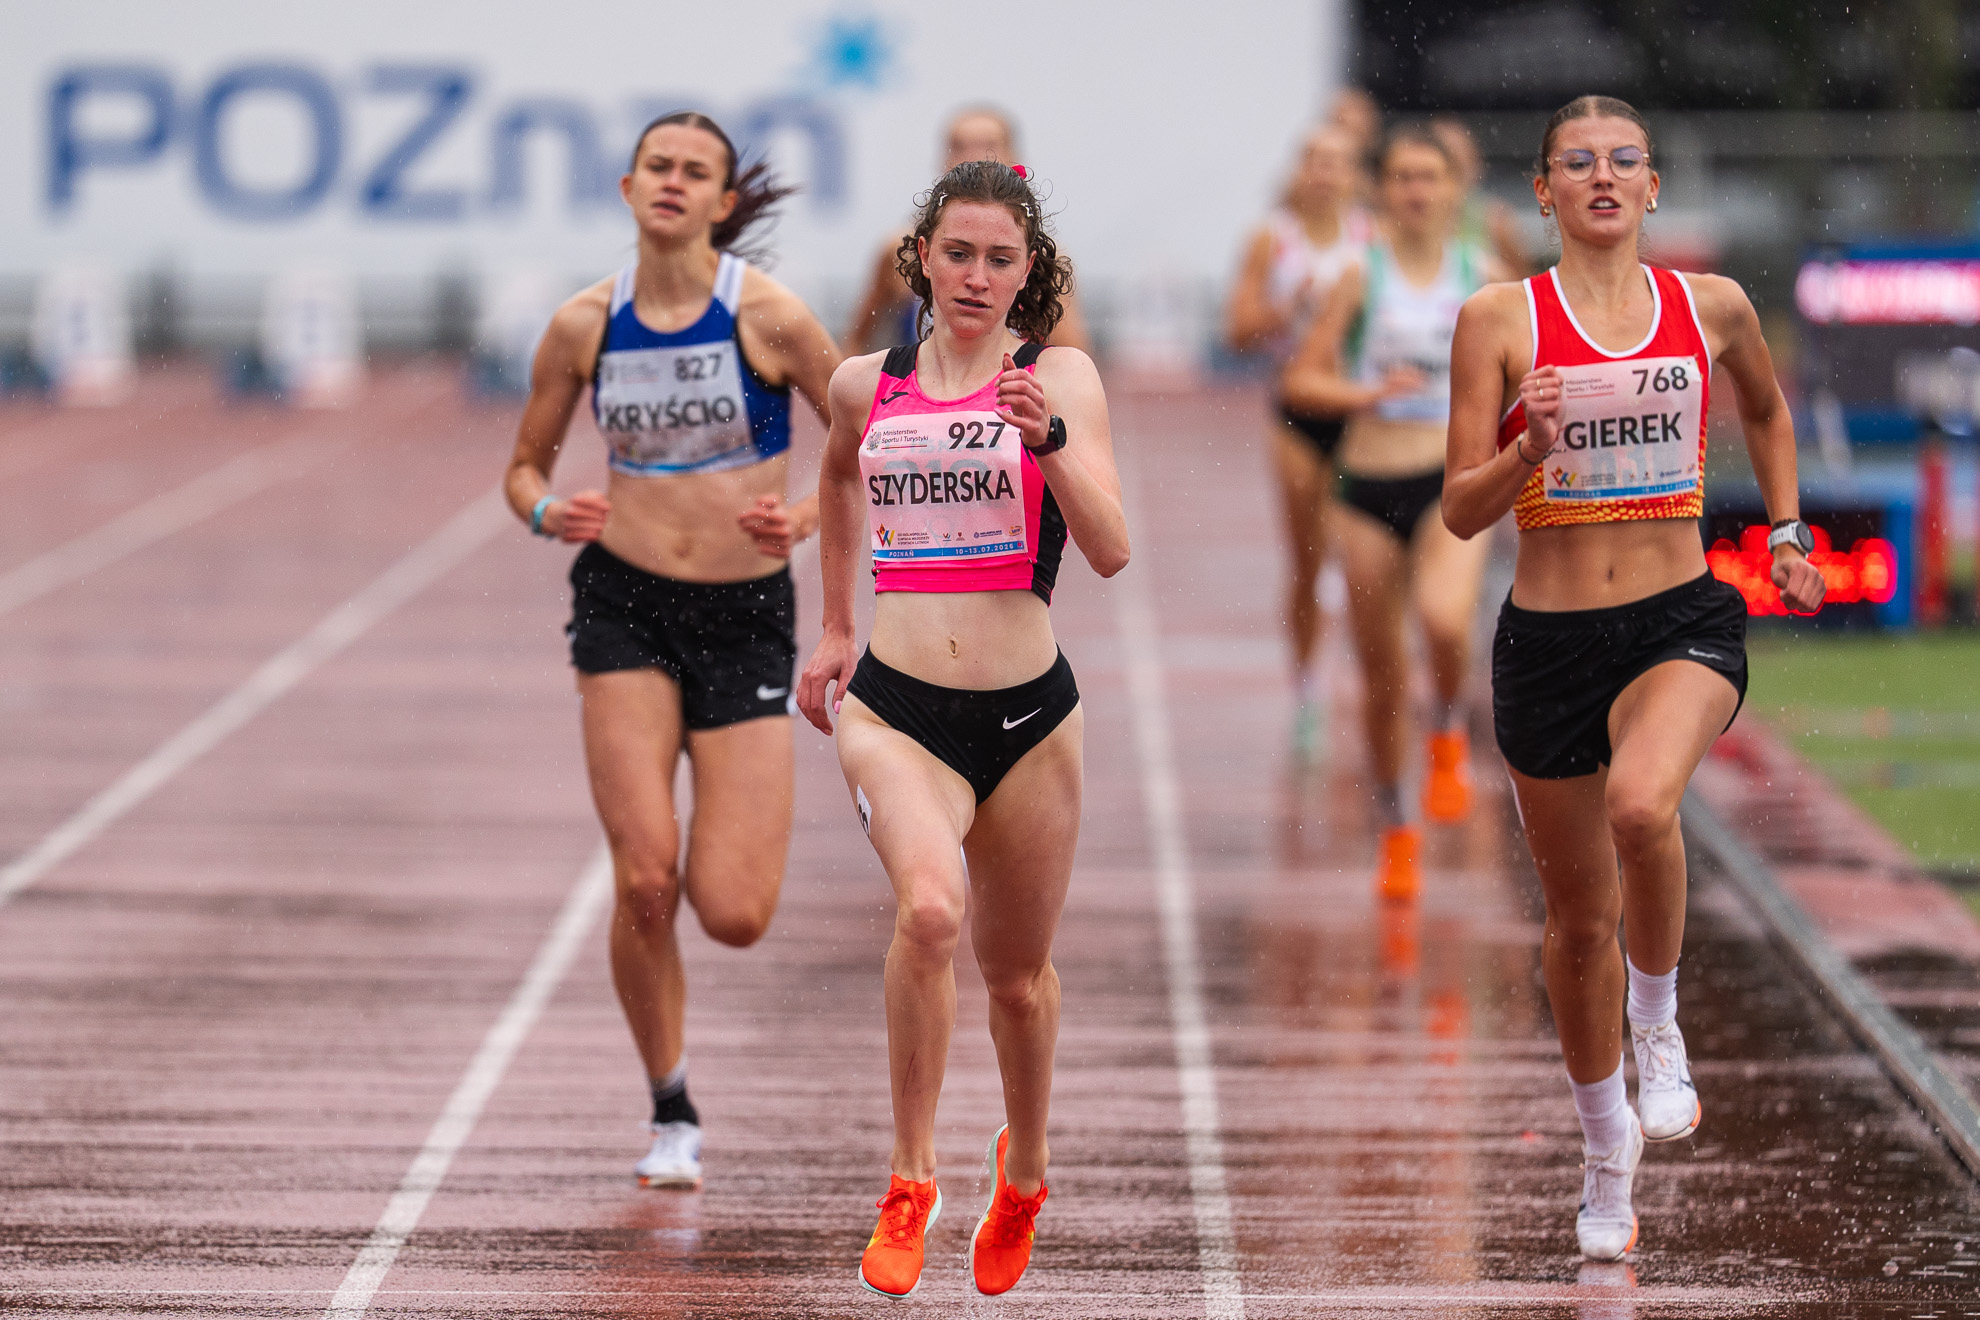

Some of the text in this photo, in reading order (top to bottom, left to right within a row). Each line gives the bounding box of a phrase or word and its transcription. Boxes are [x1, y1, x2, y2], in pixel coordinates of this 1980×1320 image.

[674, 353, 721, 382] 827
[1632, 366, 1689, 395] 768
[605, 394, 737, 432] KRYŚCIO
[883, 429, 918, 437] Ministerstwo
[904, 435, 929, 443] Turystyki
[948, 421, 1006, 450] 927
[1563, 412, 1682, 450] GIEREK
[869, 469, 1016, 506] SZYDERSKA
